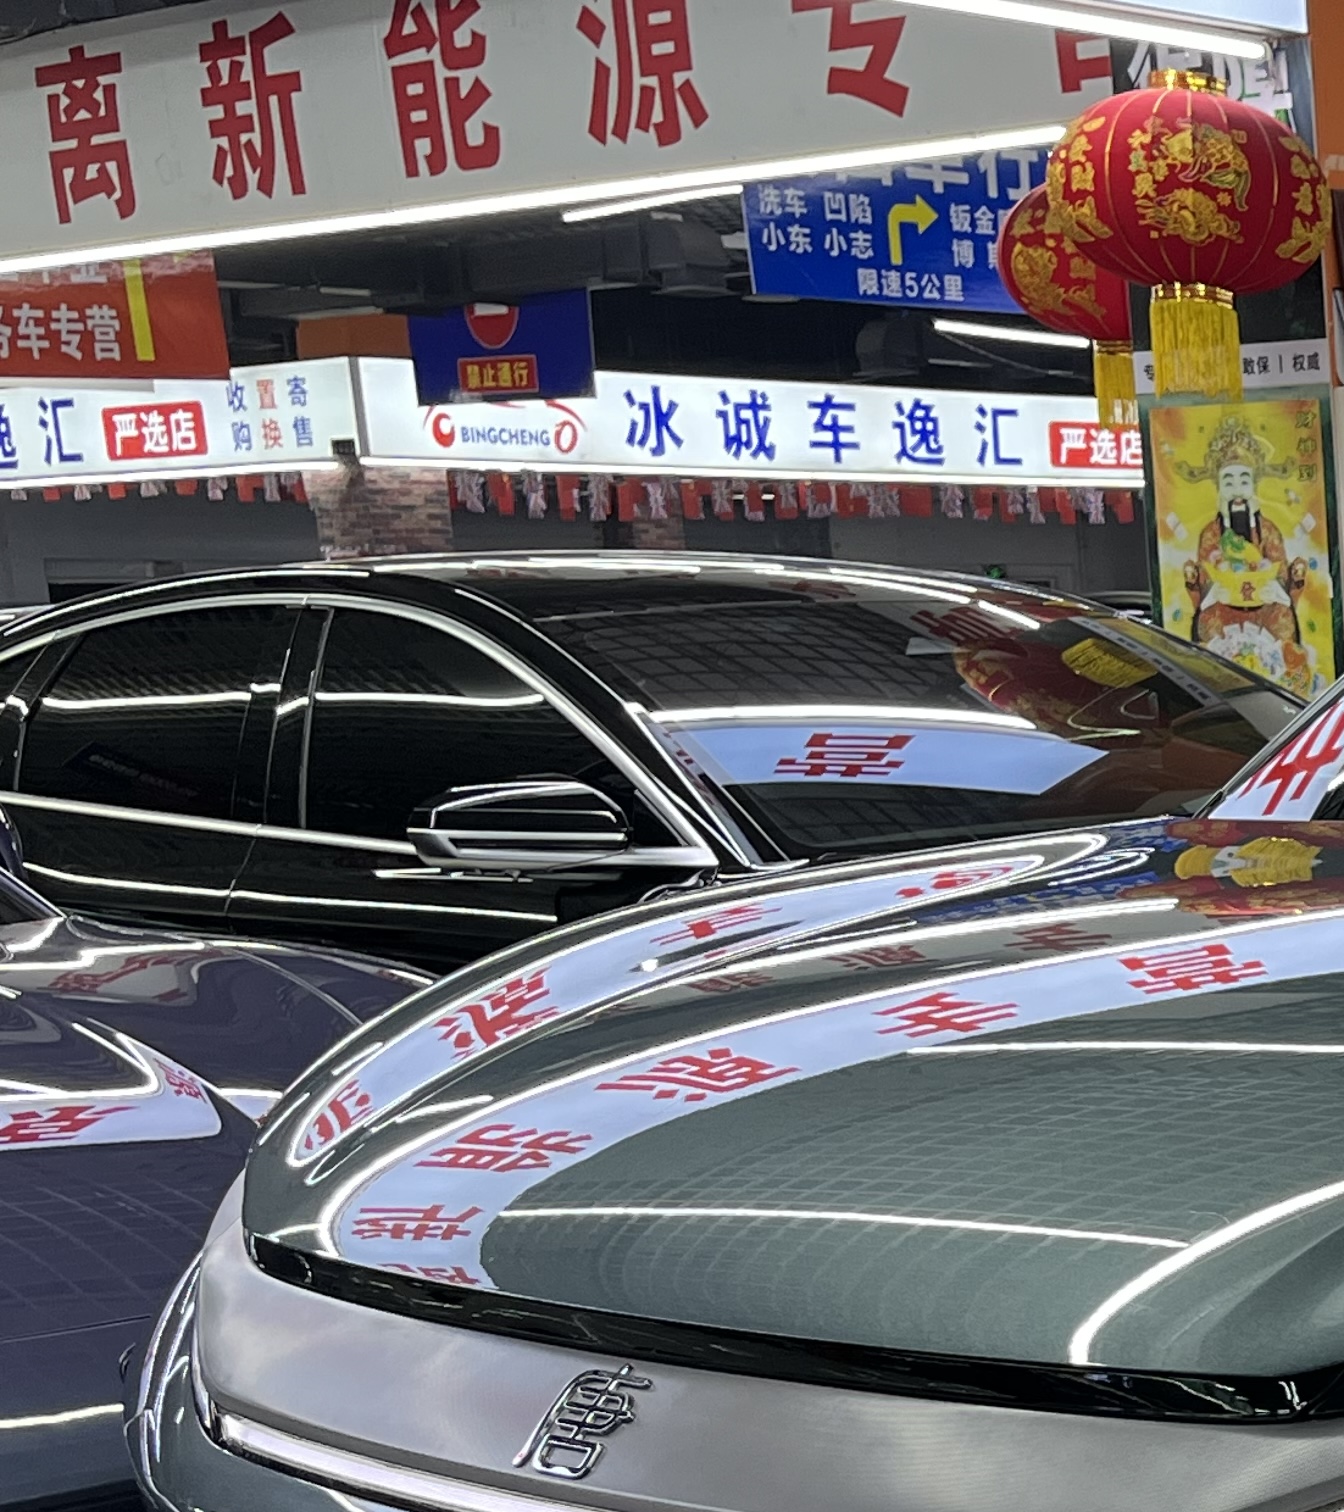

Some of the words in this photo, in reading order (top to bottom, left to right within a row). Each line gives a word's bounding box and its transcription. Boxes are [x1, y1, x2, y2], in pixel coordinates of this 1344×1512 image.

[762, 223, 813, 254] 小东
[824, 228, 874, 259] 小志
[857, 268, 965, 301] 限速5公里
[112, 409, 199, 457] 严选店
[460, 425, 551, 448] BINGCHENG
[622, 384, 1024, 467] 冰诚车逸汇
